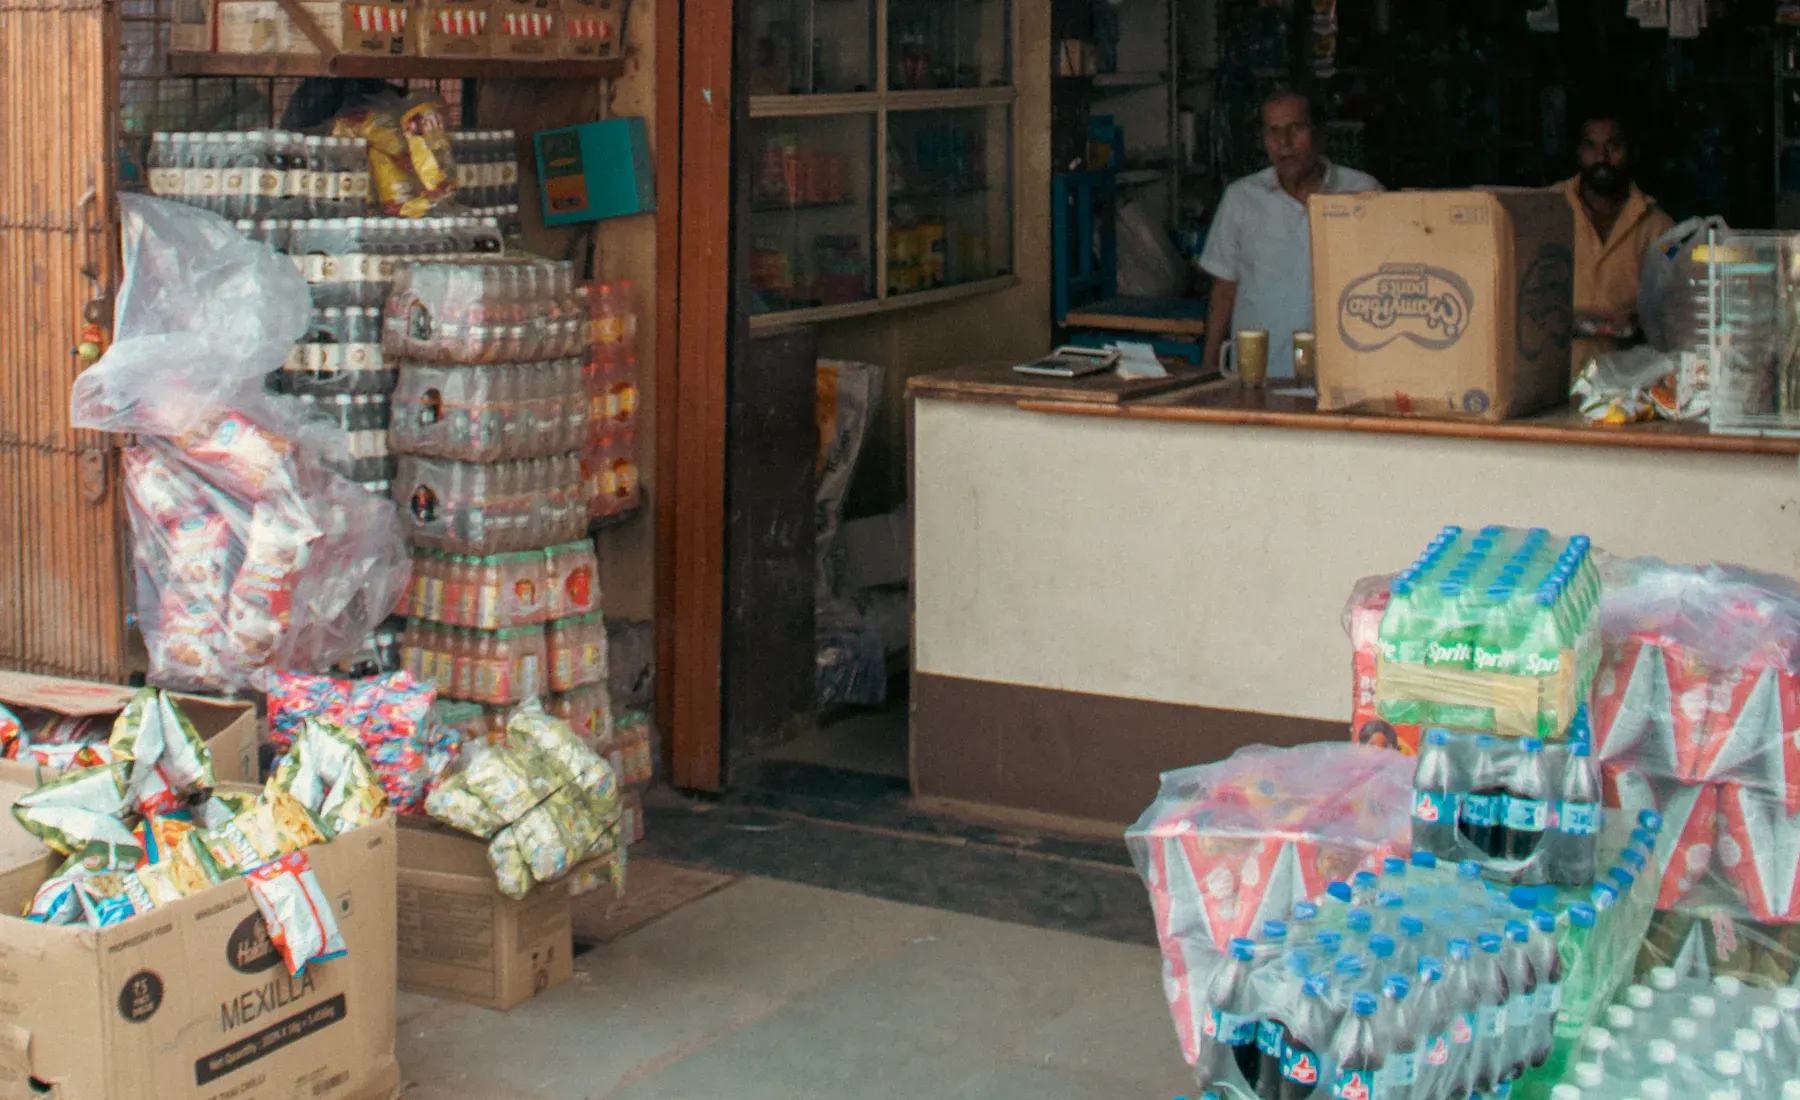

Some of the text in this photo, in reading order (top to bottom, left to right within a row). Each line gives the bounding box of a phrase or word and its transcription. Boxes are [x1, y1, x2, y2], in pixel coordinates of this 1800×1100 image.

[1378, 279, 1428, 297] pants
[1348, 292, 1463, 336] MamyPoko
[1527, 652, 1560, 675] Spri
[220, 970, 316, 1033] MEXILLA
